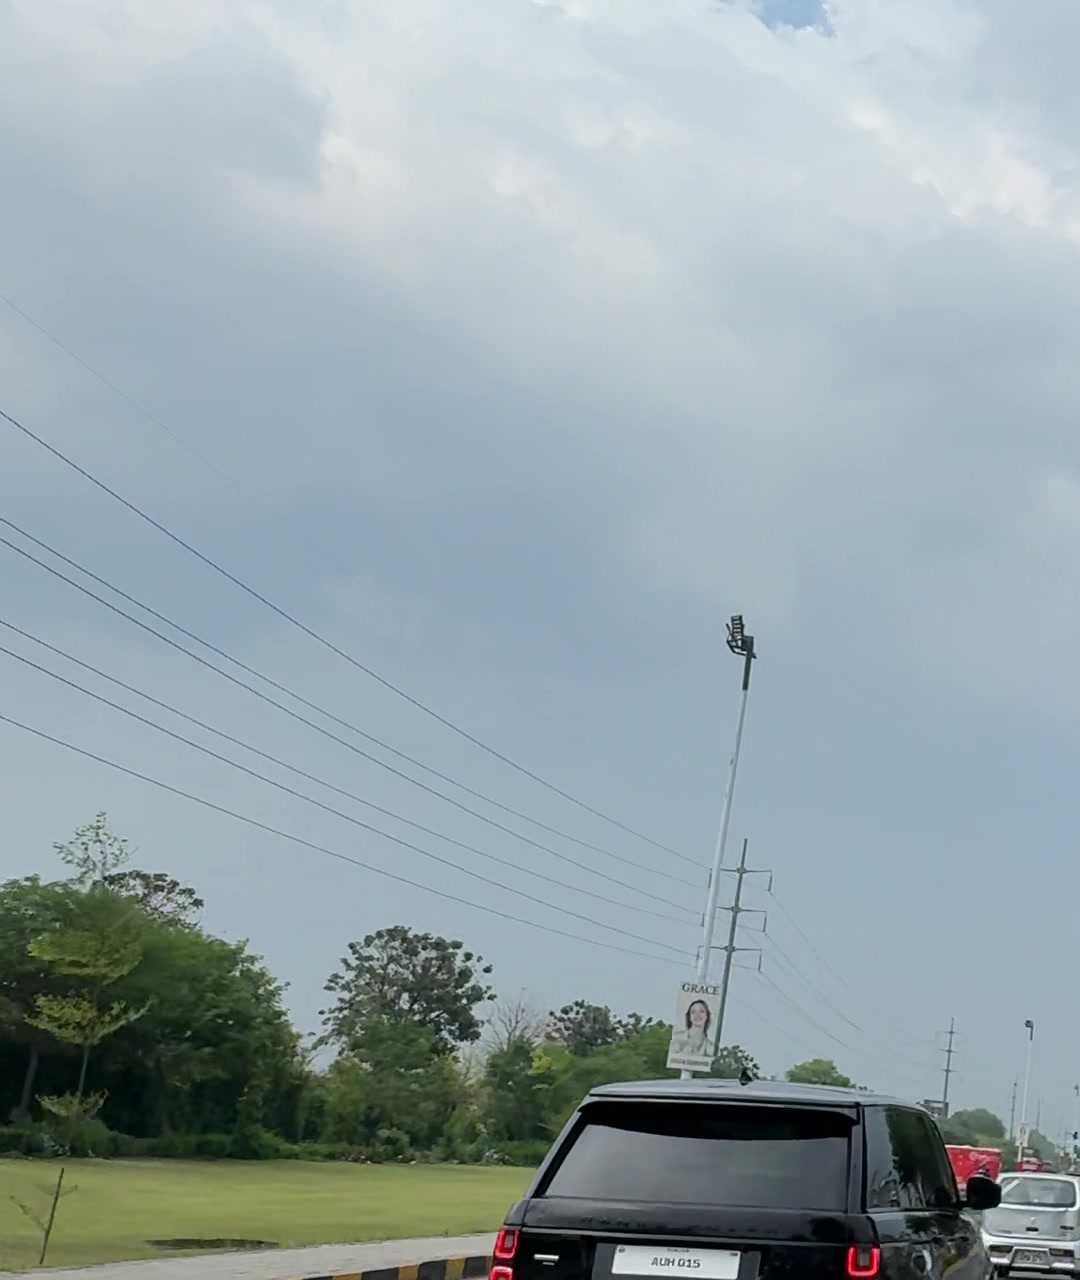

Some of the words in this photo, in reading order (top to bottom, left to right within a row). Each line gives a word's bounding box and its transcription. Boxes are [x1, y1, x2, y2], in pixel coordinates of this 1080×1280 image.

[682, 983, 720, 995] GRACE
[651, 1257, 675, 1267] AUH
[678, 1258, 701, 1269] 015
